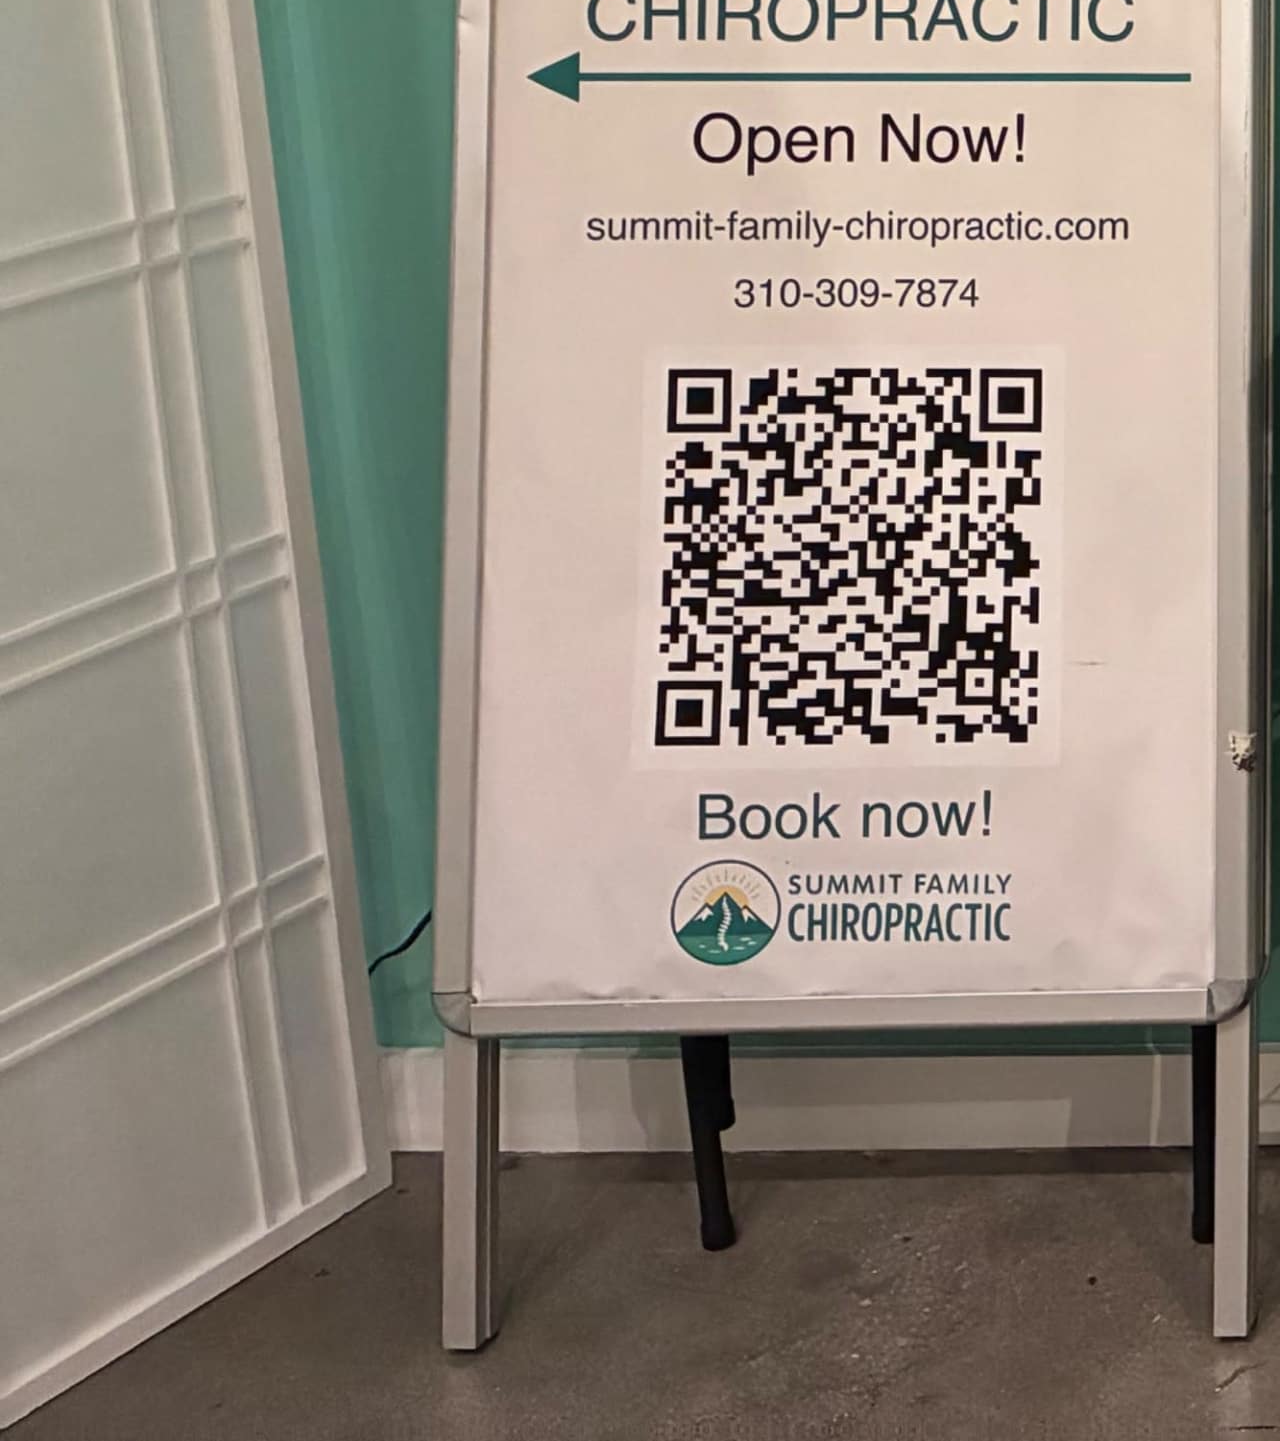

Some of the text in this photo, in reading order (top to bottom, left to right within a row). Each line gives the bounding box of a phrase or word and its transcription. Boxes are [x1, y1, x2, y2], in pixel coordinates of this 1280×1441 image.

[692, 112, 1026, 177] Open Now!
[586, 210, 1130, 248] summit-family-chiropractic.com
[734, 278, 980, 309] 310-309-7874
[698, 789, 993, 841] Book now!
[788, 873, 1012, 895] SUMMIT FAMILY
[788, 903, 1012, 942] CHIROPRACTIC
